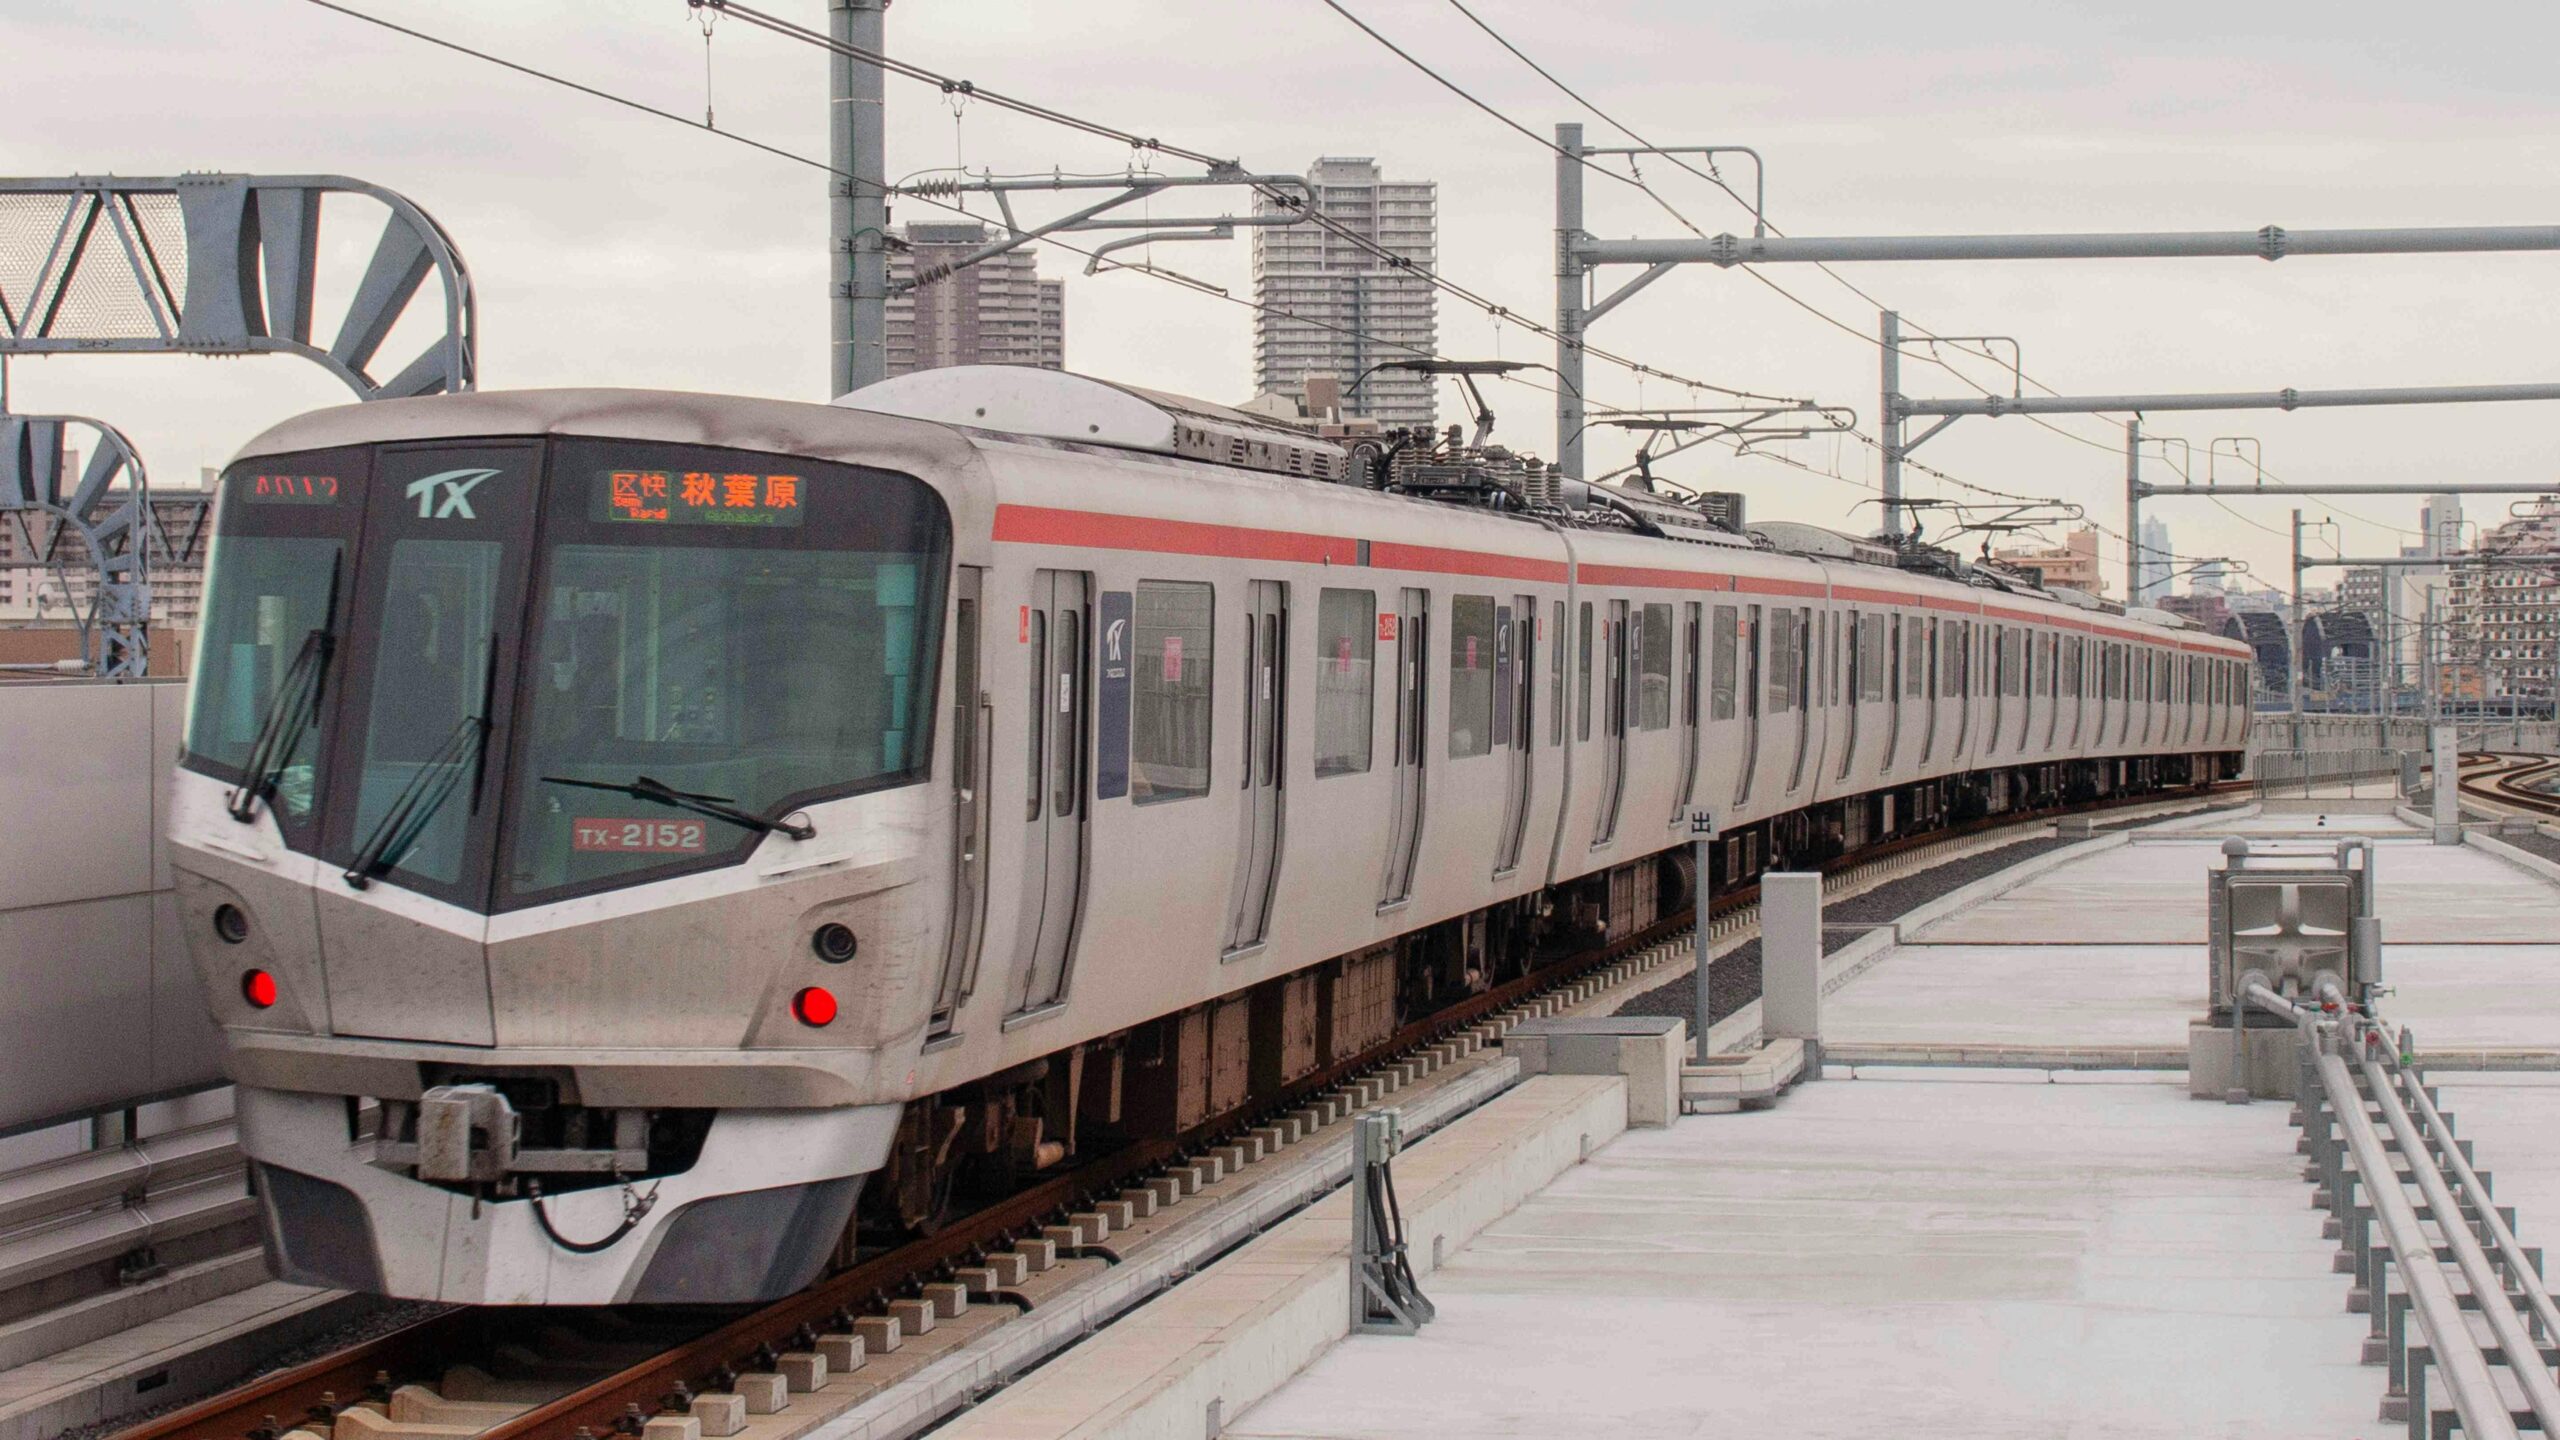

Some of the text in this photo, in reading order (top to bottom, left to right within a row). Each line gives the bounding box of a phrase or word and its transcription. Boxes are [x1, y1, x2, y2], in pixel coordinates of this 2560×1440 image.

[406, 468, 503, 519] TX
[612, 473, 667, 498] 区快
[680, 472, 799, 509] 秋葉原
[1107, 618, 1126, 661] TX
[579, 823, 701, 848] TX-2152
[1691, 811, 1711, 834] 出
